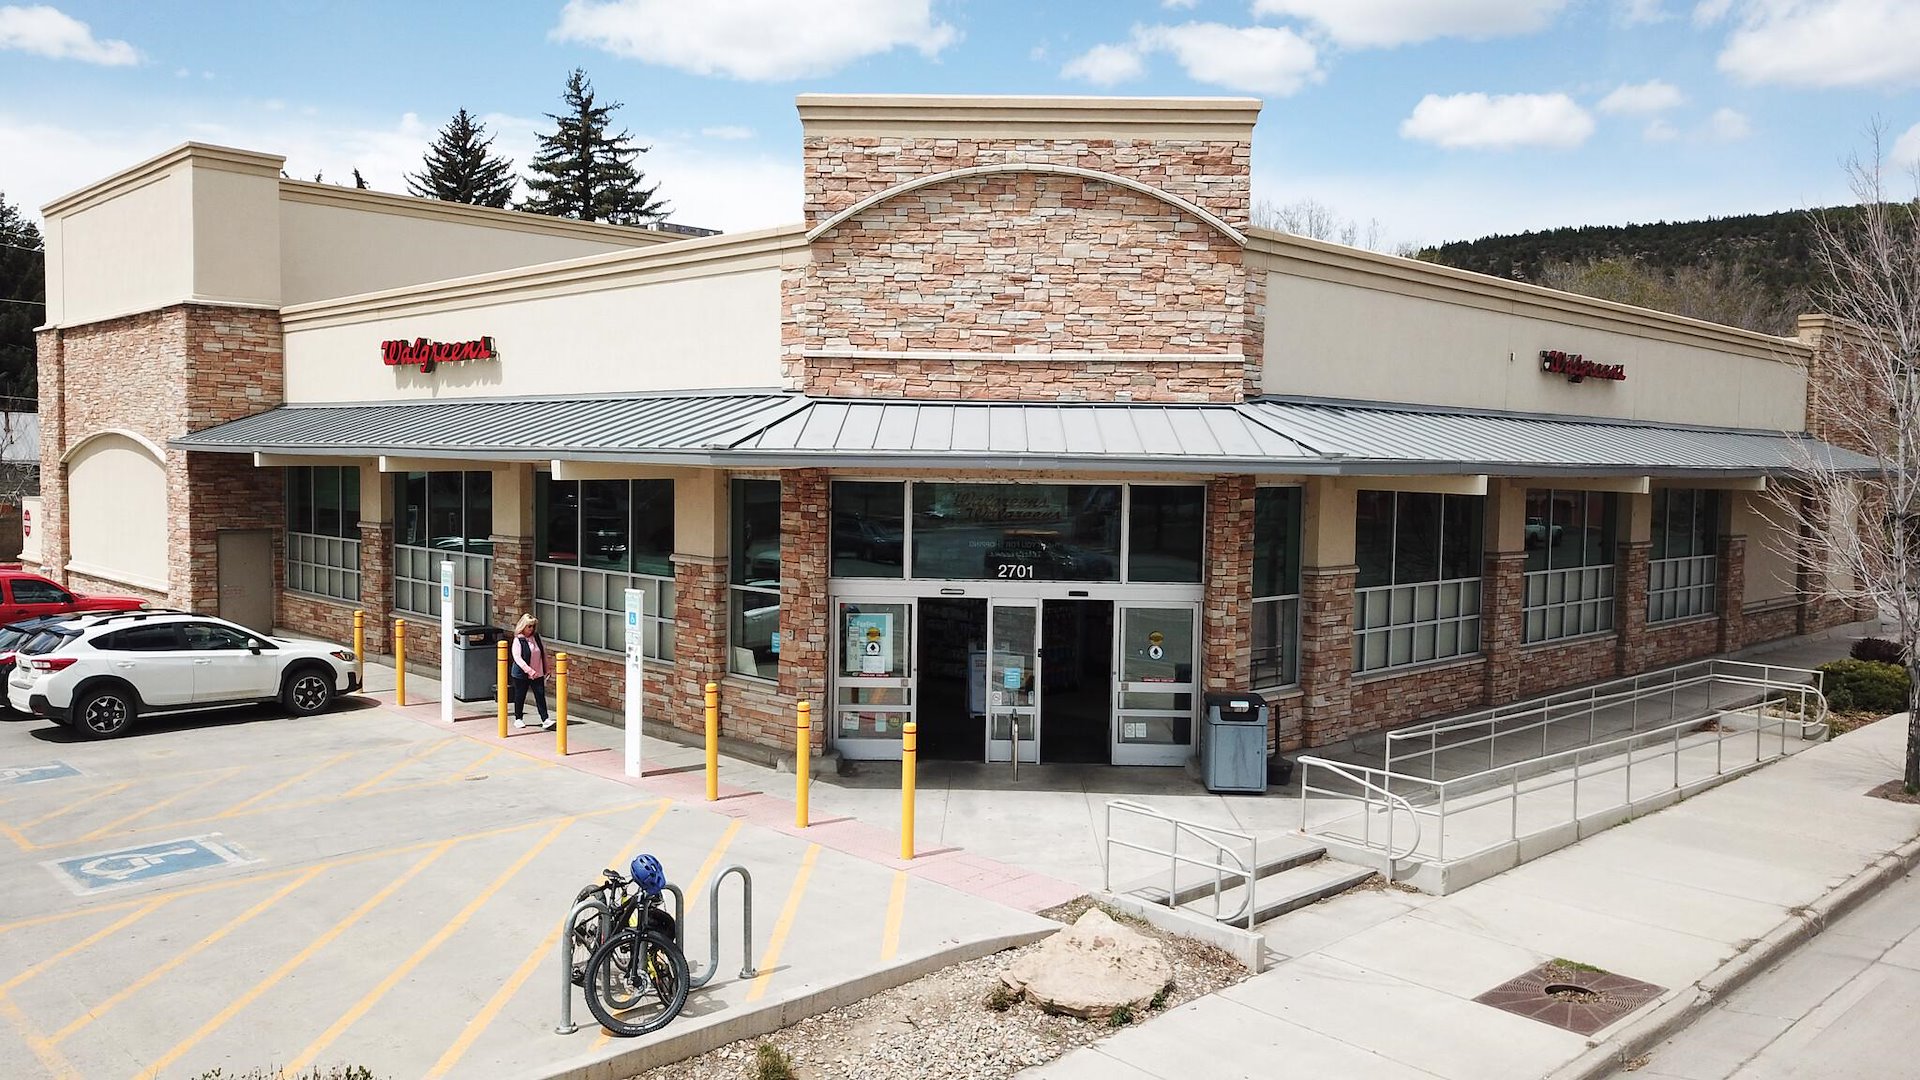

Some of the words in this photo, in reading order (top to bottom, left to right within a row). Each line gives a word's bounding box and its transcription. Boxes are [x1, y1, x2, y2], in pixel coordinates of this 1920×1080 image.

[381, 336, 496, 373] Walgreens
[1540, 350, 1626, 383] Walgreens
[997, 564, 1033, 579] 2701
